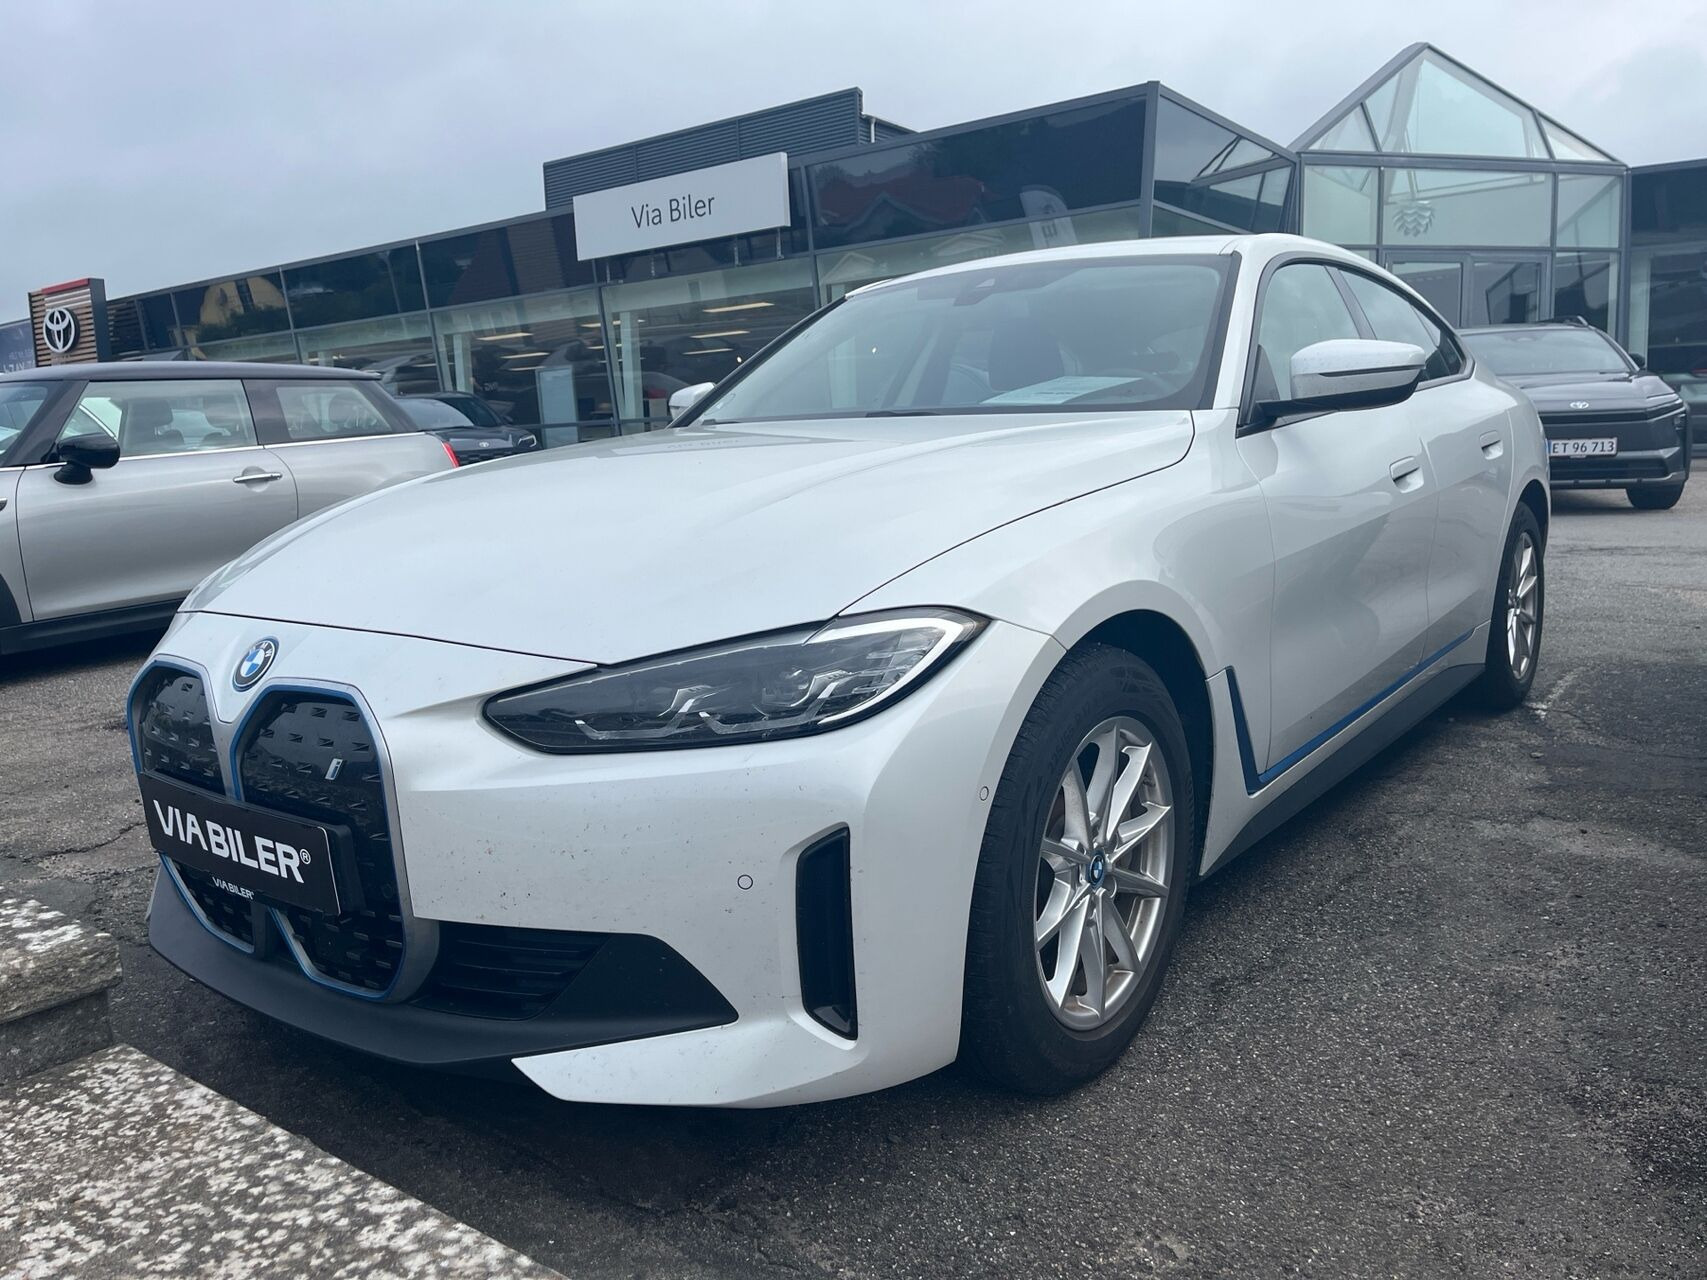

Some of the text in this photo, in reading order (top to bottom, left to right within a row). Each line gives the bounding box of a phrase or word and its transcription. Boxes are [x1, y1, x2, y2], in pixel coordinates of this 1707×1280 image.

[631, 193, 715, 229] Via Biler
[1552, 441, 1615, 454] ET 96 713
